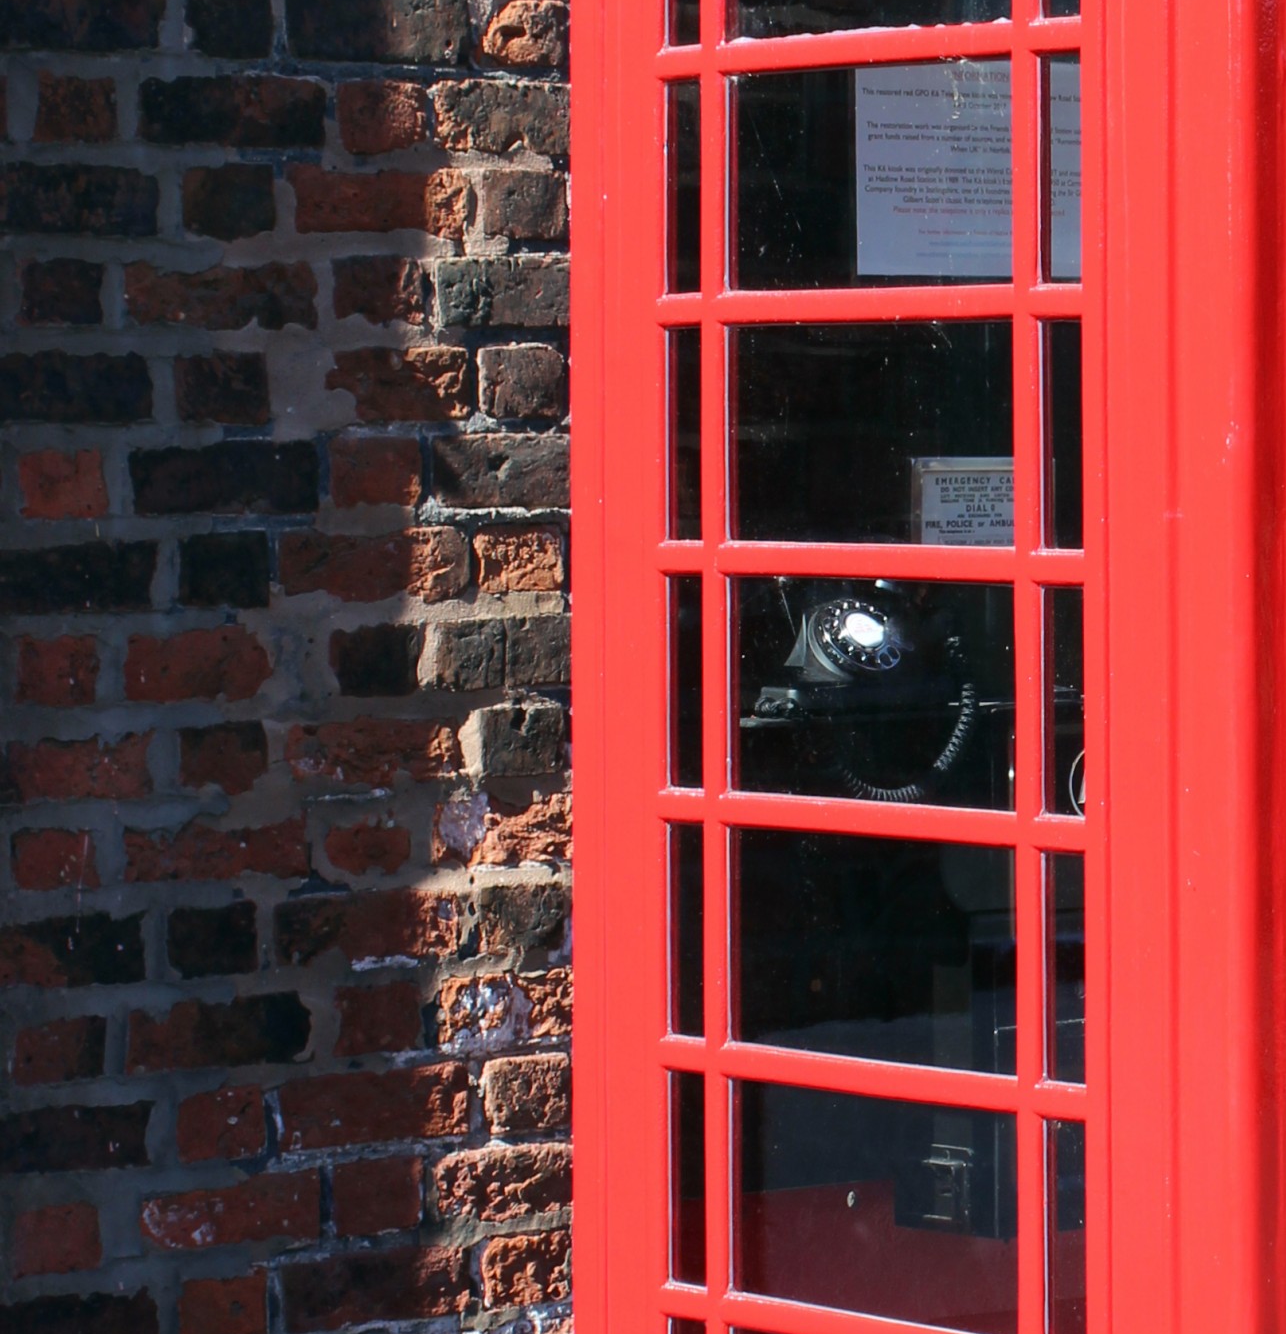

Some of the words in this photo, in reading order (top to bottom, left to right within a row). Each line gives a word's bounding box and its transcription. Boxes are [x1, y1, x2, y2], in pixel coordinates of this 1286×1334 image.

[935, 476, 991, 485] EMERGENCY
[966, 504, 987, 512] DIAL
[946, 519, 973, 527] POLICE
